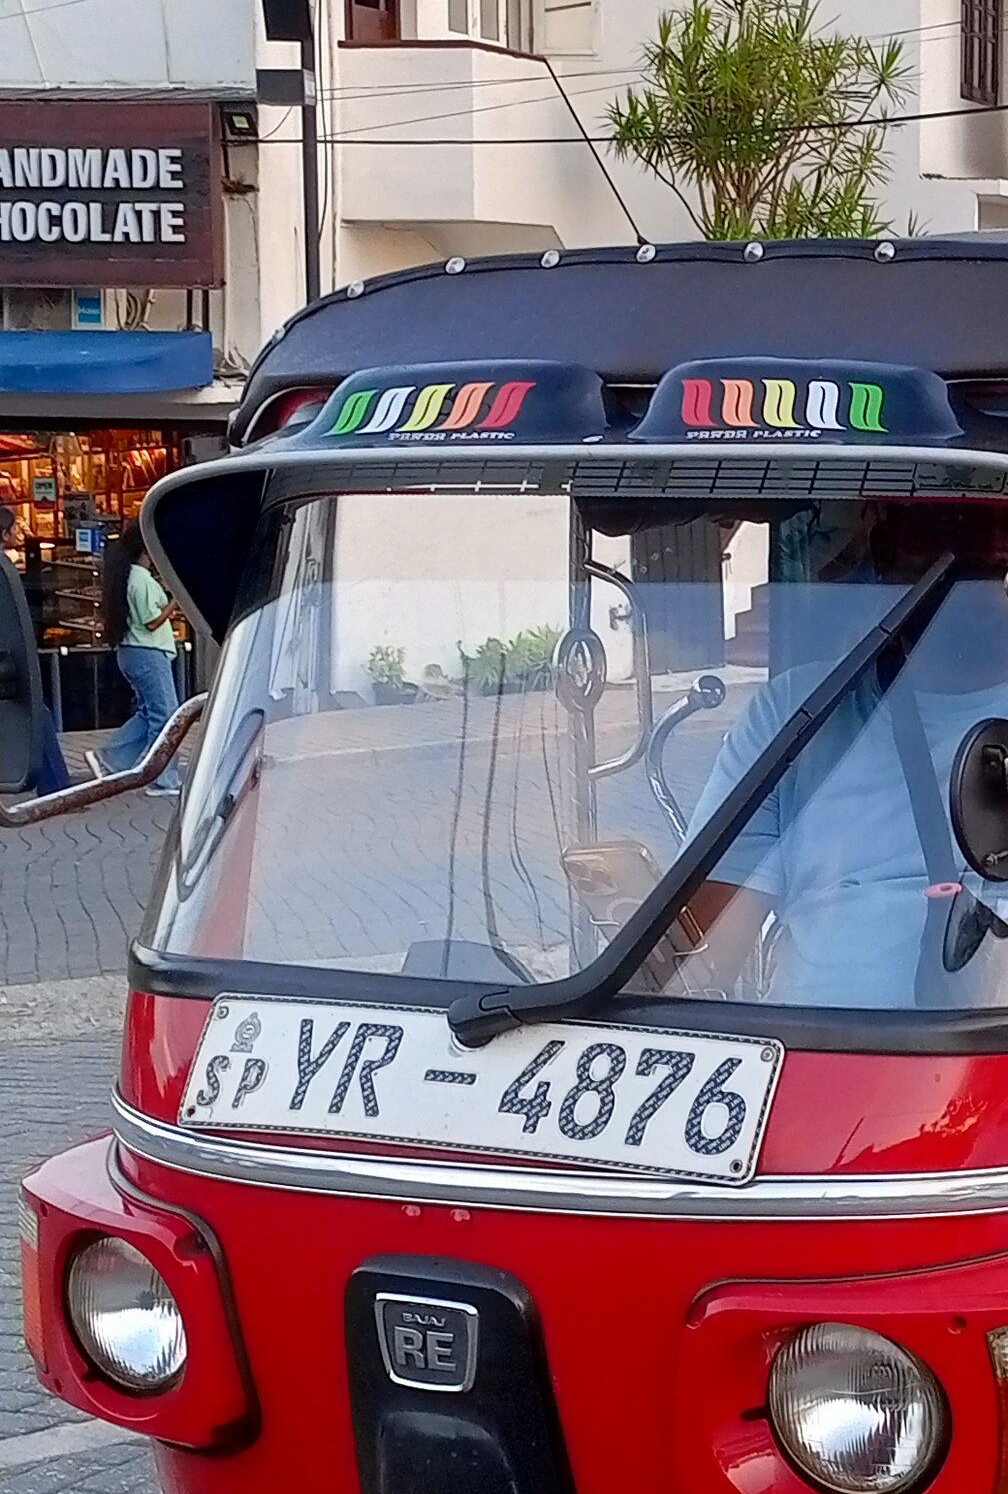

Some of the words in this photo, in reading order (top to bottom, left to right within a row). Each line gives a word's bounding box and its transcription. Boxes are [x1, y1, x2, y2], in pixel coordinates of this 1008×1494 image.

[450, 431, 515, 440] PLASTIC
[752, 429, 821, 438] PLASTIC
[196, 1054, 270, 1110] SP
[289, 1018, 403, 1117] YR
[498, 1039, 748, 1157] 4876
[402, 1312, 446, 1327] BAJAJ
[394, 1325, 457, 1372] RE
